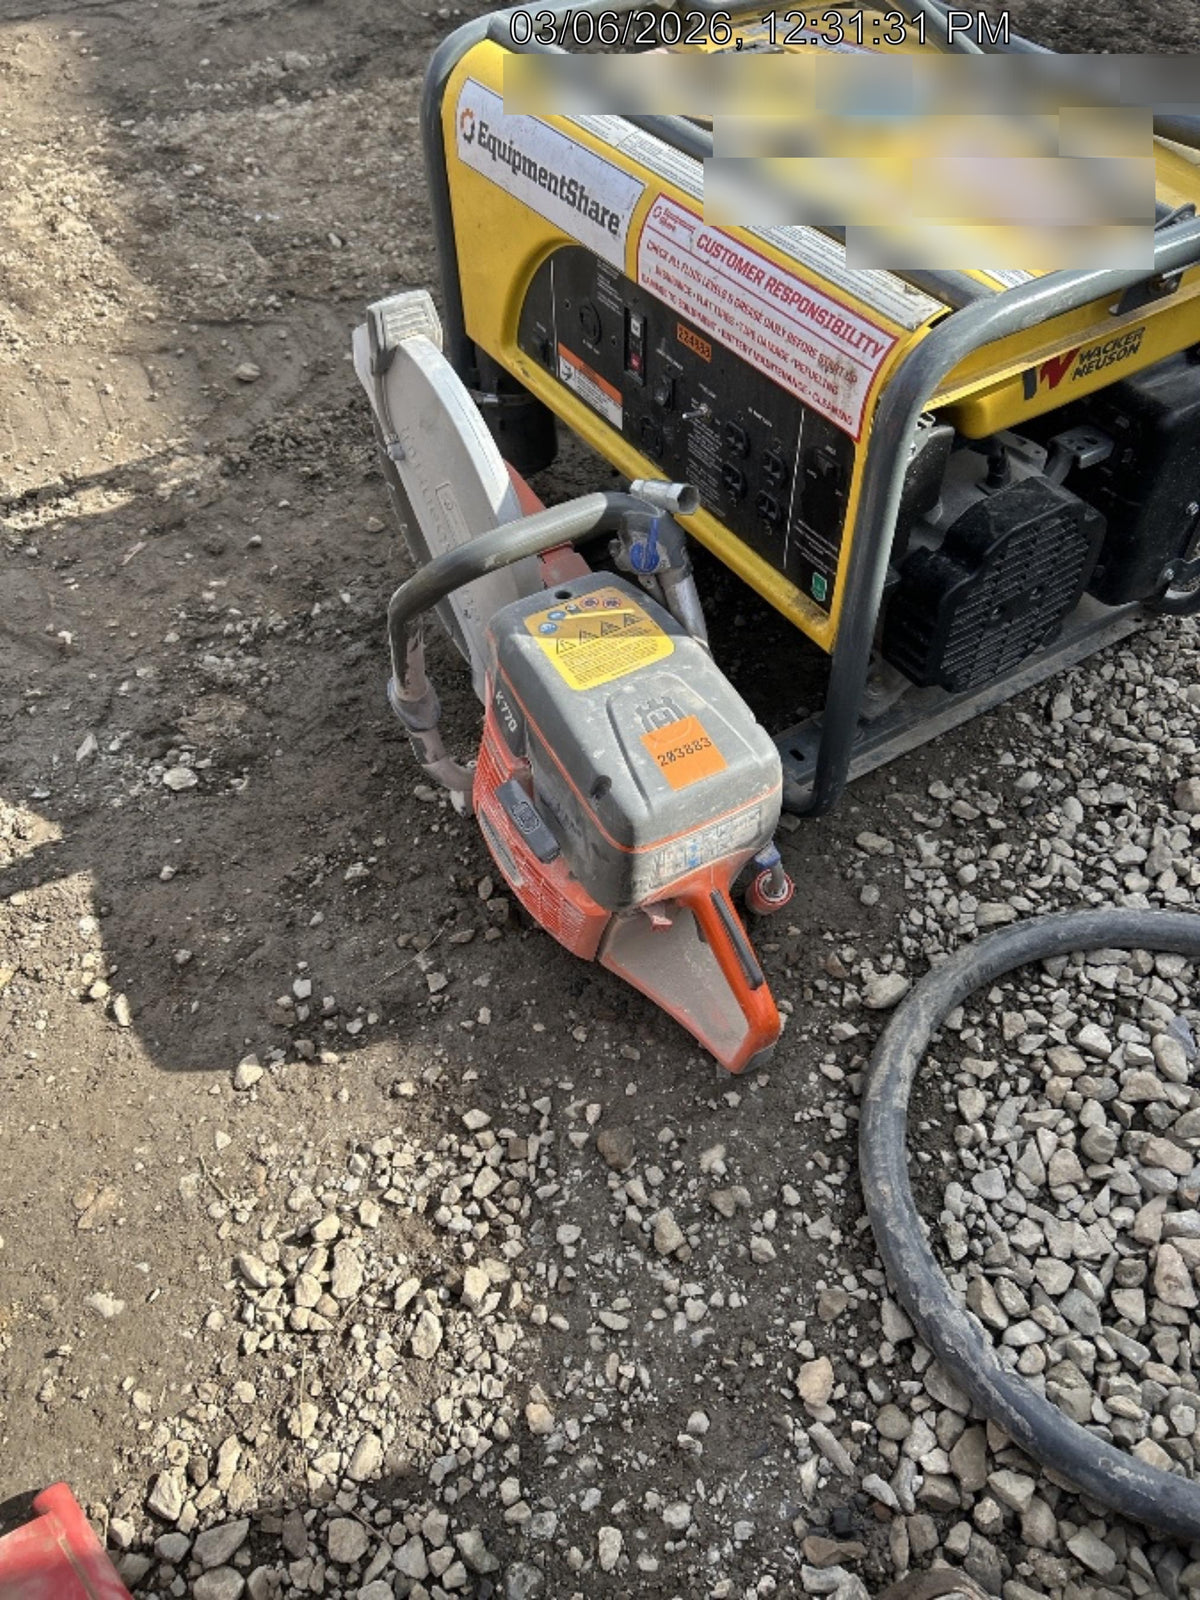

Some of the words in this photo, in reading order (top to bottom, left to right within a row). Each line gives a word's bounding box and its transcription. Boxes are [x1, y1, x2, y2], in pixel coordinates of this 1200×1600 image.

[477, 119, 621, 236] EquipmentShare
[696, 233, 766, 287] CUSTOMER
[764, 275, 885, 360] RESPONSIBILITY
[734, 298, 764, 324] GREASE
[764, 317, 787, 338] DAILY
[787, 331, 818, 359] BEFORE
[817, 352, 845, 376] START
[1079, 325, 1146, 364] WACKER
[793, 358, 839, 396] REFUELING
[1071, 340, 1141, 382] NEUSON
[657, 737, 713, 768] 203883
